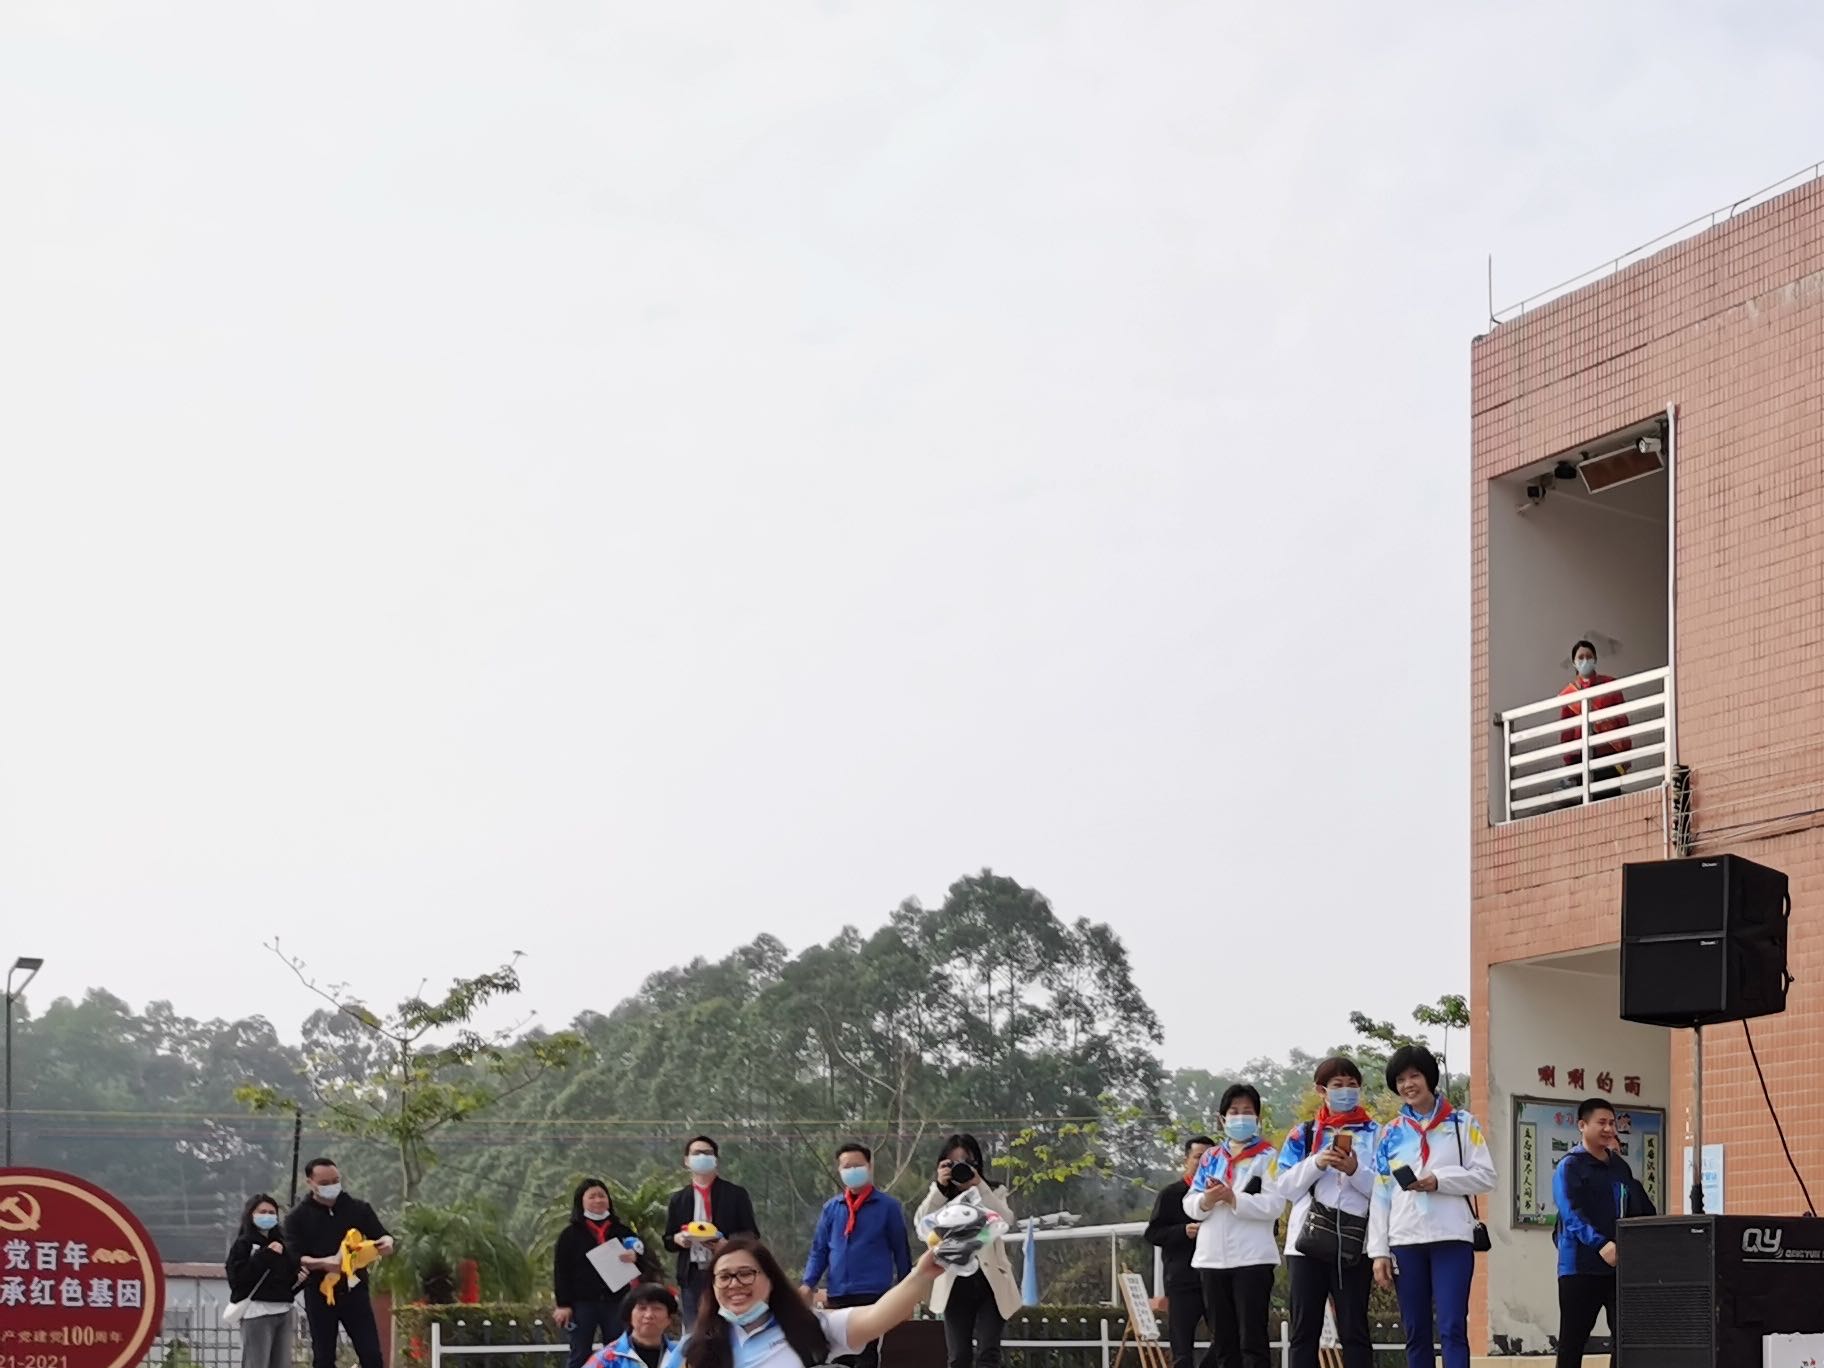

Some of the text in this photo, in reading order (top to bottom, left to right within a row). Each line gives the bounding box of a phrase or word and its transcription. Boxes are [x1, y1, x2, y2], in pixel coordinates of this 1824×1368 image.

[1538, 1065, 1641, 1097] 唰唰的雨
[4, 1239, 89, 1271] 党百年
